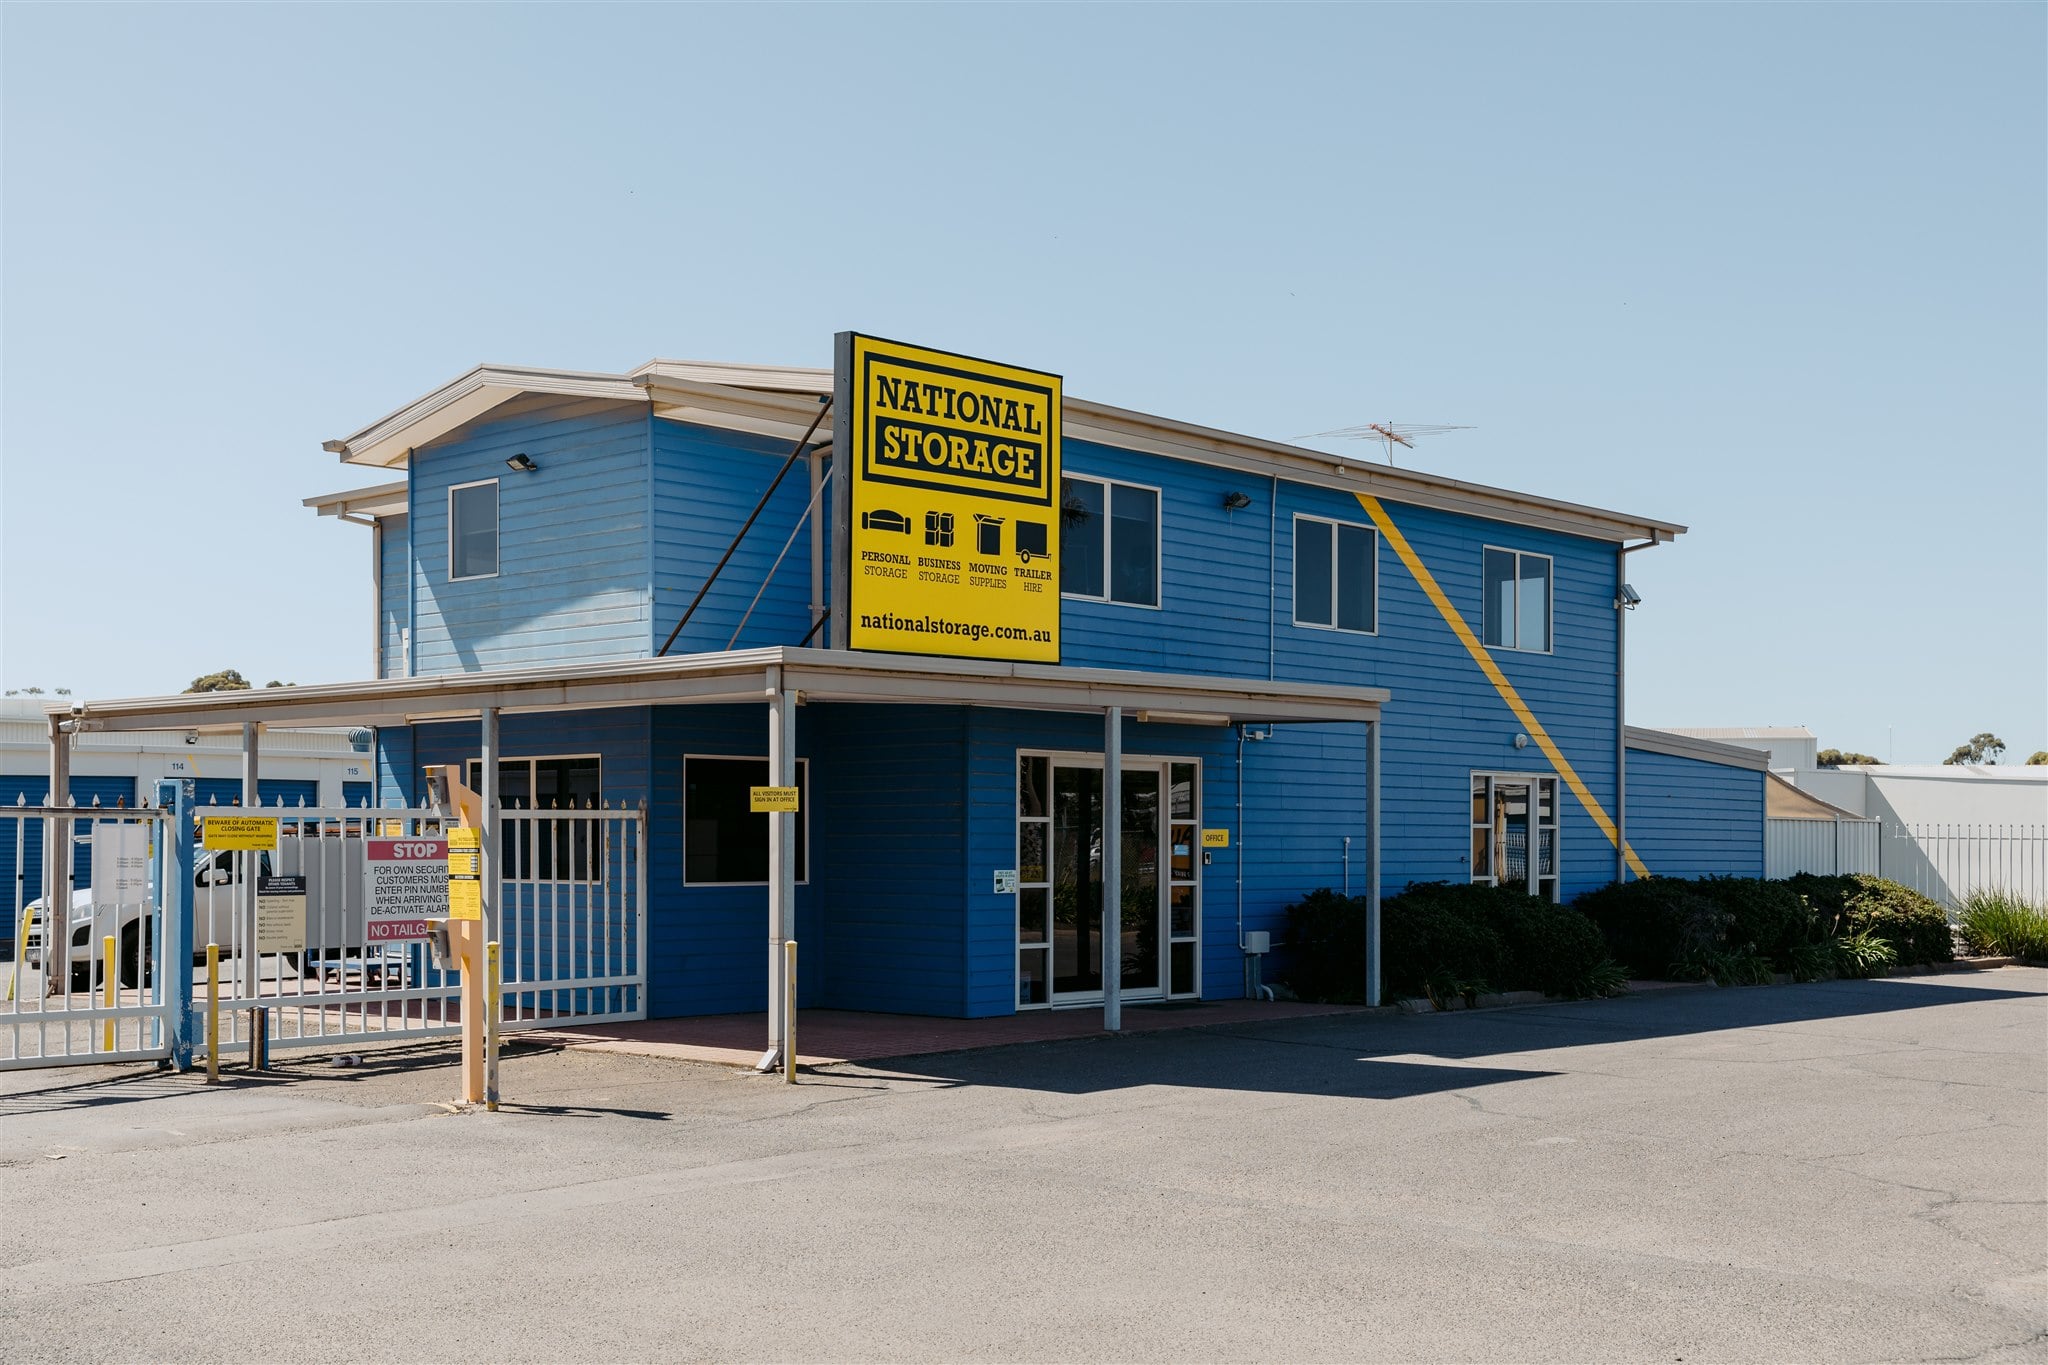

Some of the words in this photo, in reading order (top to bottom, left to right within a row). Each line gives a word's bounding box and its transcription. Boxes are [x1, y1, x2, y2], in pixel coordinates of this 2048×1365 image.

[876, 375, 1041, 436] NATIONAL
[884, 424, 1035, 481] STORAGE
[861, 550, 911, 565] PERSONAL
[918, 557, 961, 571] BUSINESS
[864, 565, 907, 579] STORAGE
[969, 562, 1007, 576] MOVING
[1014, 567, 1052, 581] TRAILER
[918, 570, 960, 585] STORAGE
[969, 576, 1007, 590] SUPPLIES
[1023, 581, 1043, 593] HIRE
[861, 612, 1052, 643] nationalstorage.com.au
[172, 763, 184, 771] 114
[347, 768, 359, 776] 115
[1205, 834, 1224, 842] OFFICE
[393, 843, 437, 858] STOP
[374, 866, 392, 875] FOR
[393, 866, 413, 874] OWN
[416, 865, 449, 874] SECURIT
[377, 876, 429, 885] CUSTOMERS
[431, 875, 449, 884] MUS
[375, 886, 402, 895] ENTER
[404, 886, 418, 894] PIN
[420, 885, 449, 894] NUMBE
[375, 896, 402, 905] WHEN
[403, 895, 442, 904] ARRIVING
[444, 895, 449, 903] T
[371, 905, 424, 915] DE-ACTIVATE
[371, 925, 389, 937] NO
